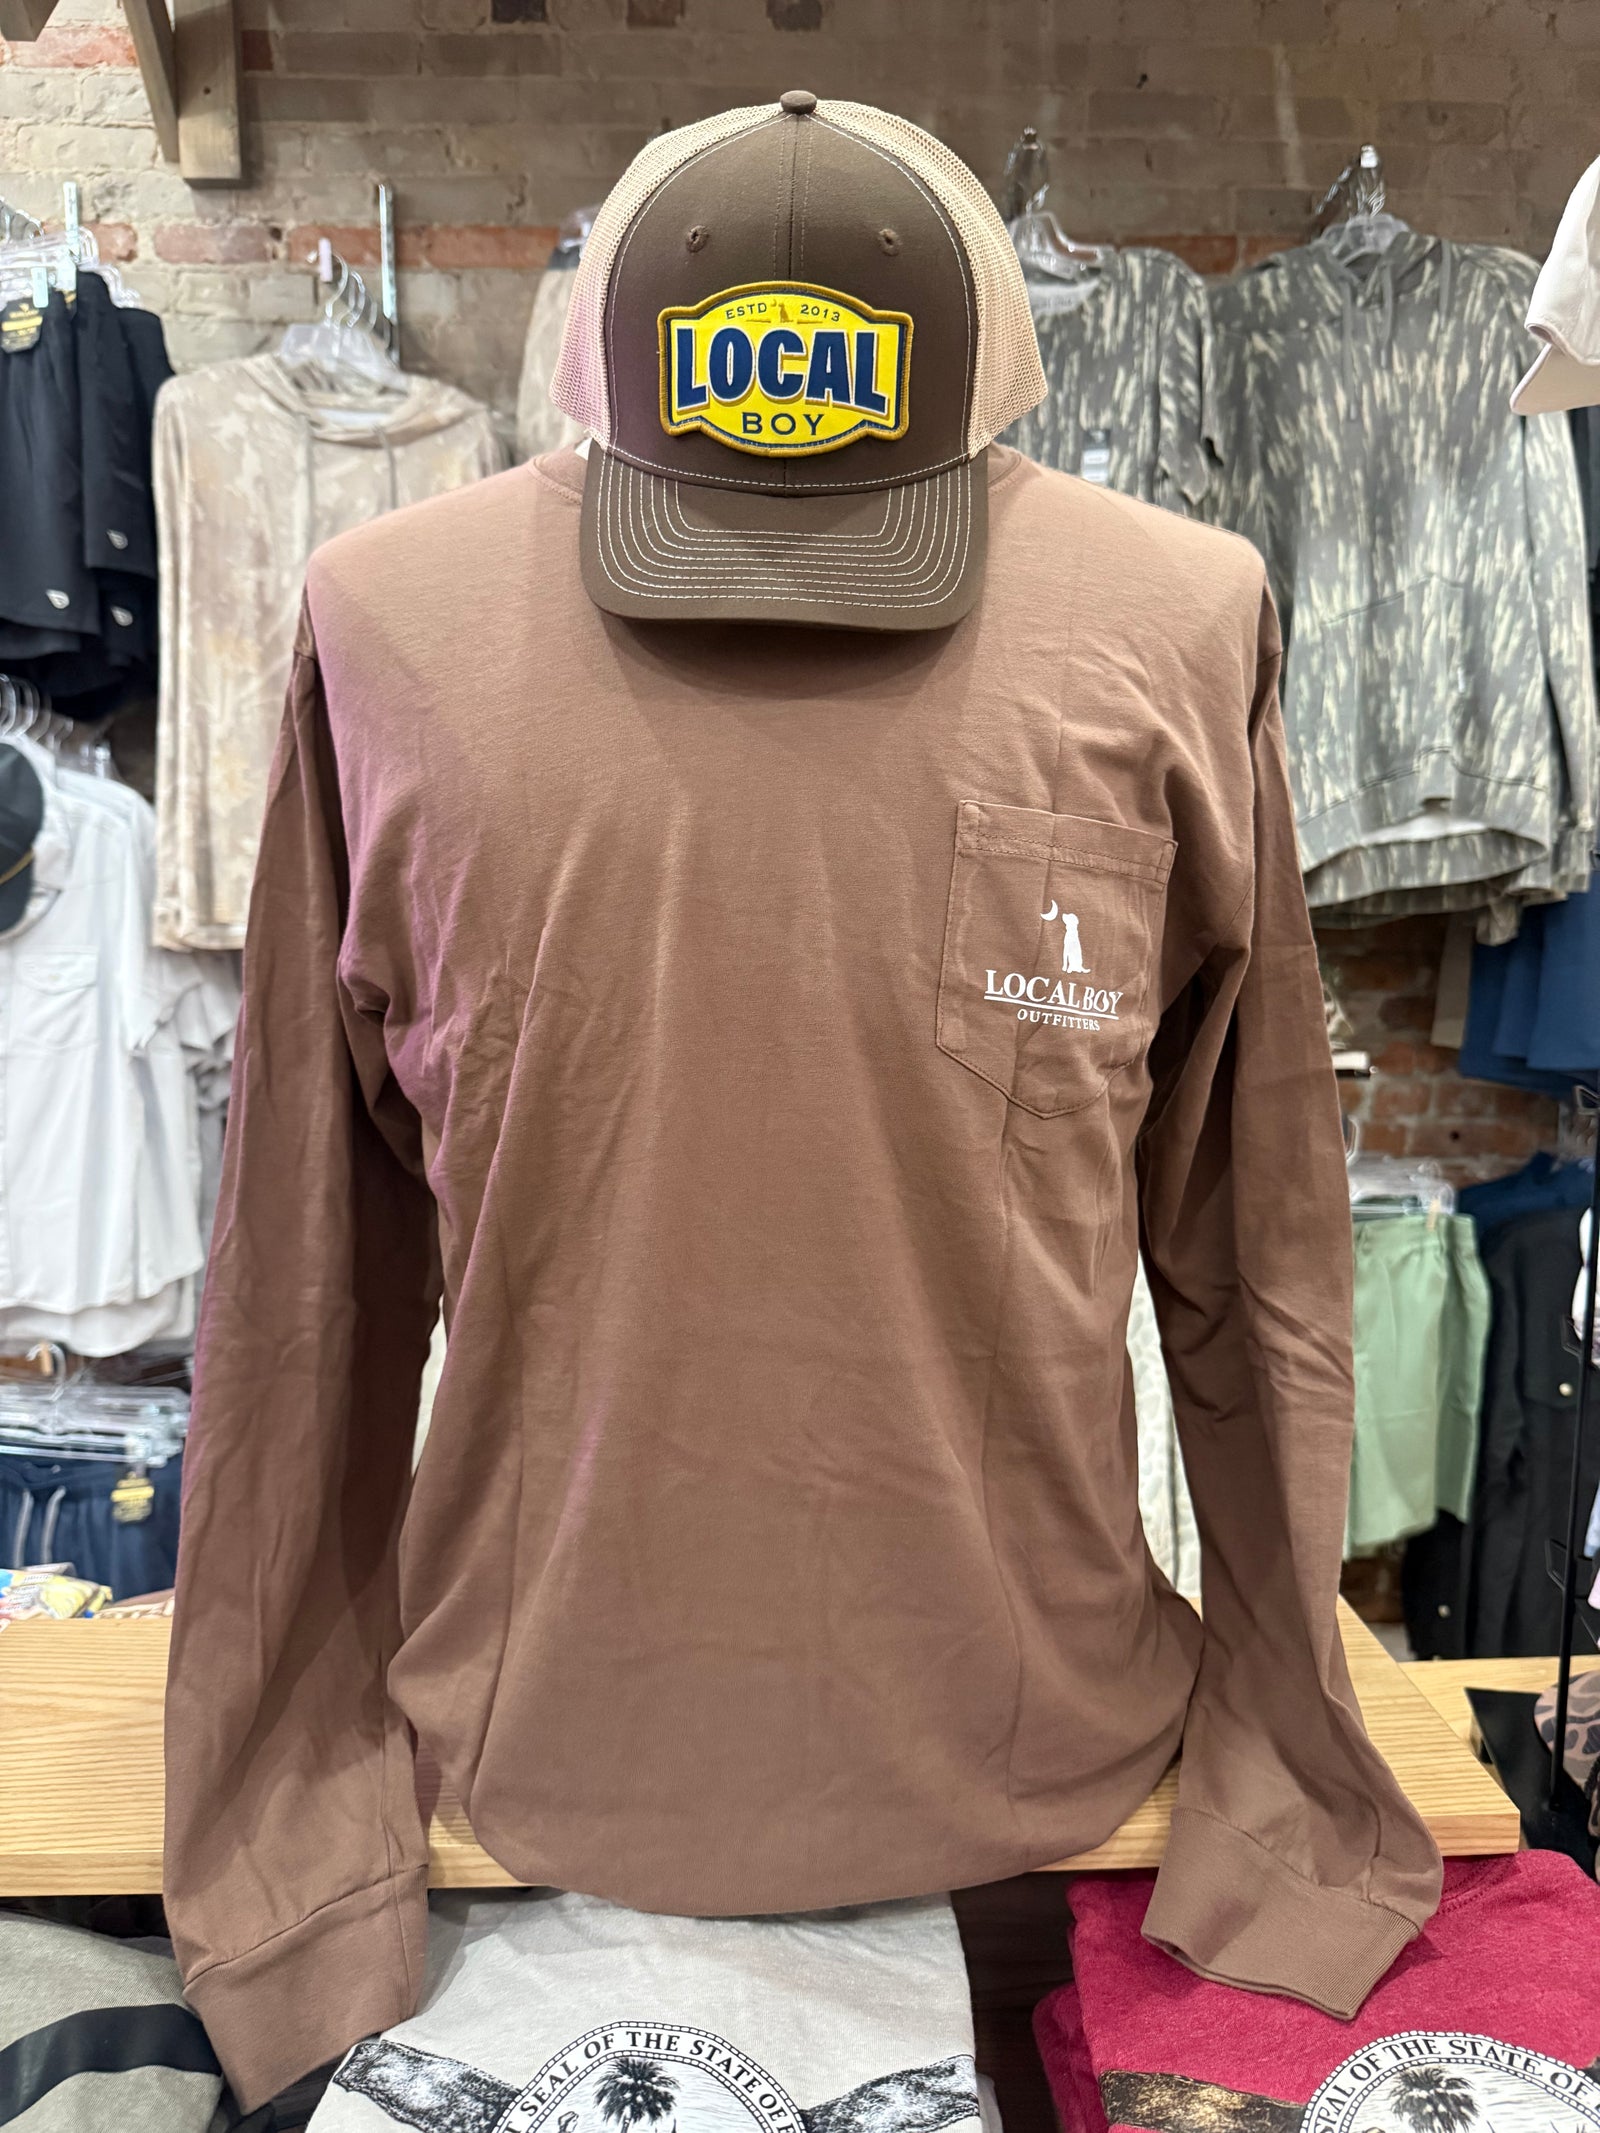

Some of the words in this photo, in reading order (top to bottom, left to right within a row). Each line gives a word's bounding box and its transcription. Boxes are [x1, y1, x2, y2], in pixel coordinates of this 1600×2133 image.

[726, 302, 767, 319] ESTD
[800, 304, 840, 322] 2013
[674, 325, 891, 415] LOCAL
[742, 412, 824, 436] BOY
[1017, 1008, 1100, 1031] OUTFITTERS
[520, 2060, 579, 2117] SEAL
[584, 2033, 615, 2059] OF
[625, 2031, 680, 2052] THE
[689, 2039, 762, 2094] STATE
[759, 2093, 788, 2122] OF
[1350, 2053, 1383, 2081] OF
[1382, 2038, 1441, 2061] THE
[1448, 2039, 1543, 2076] STATE
[1550, 2072, 1593, 2100] OF
